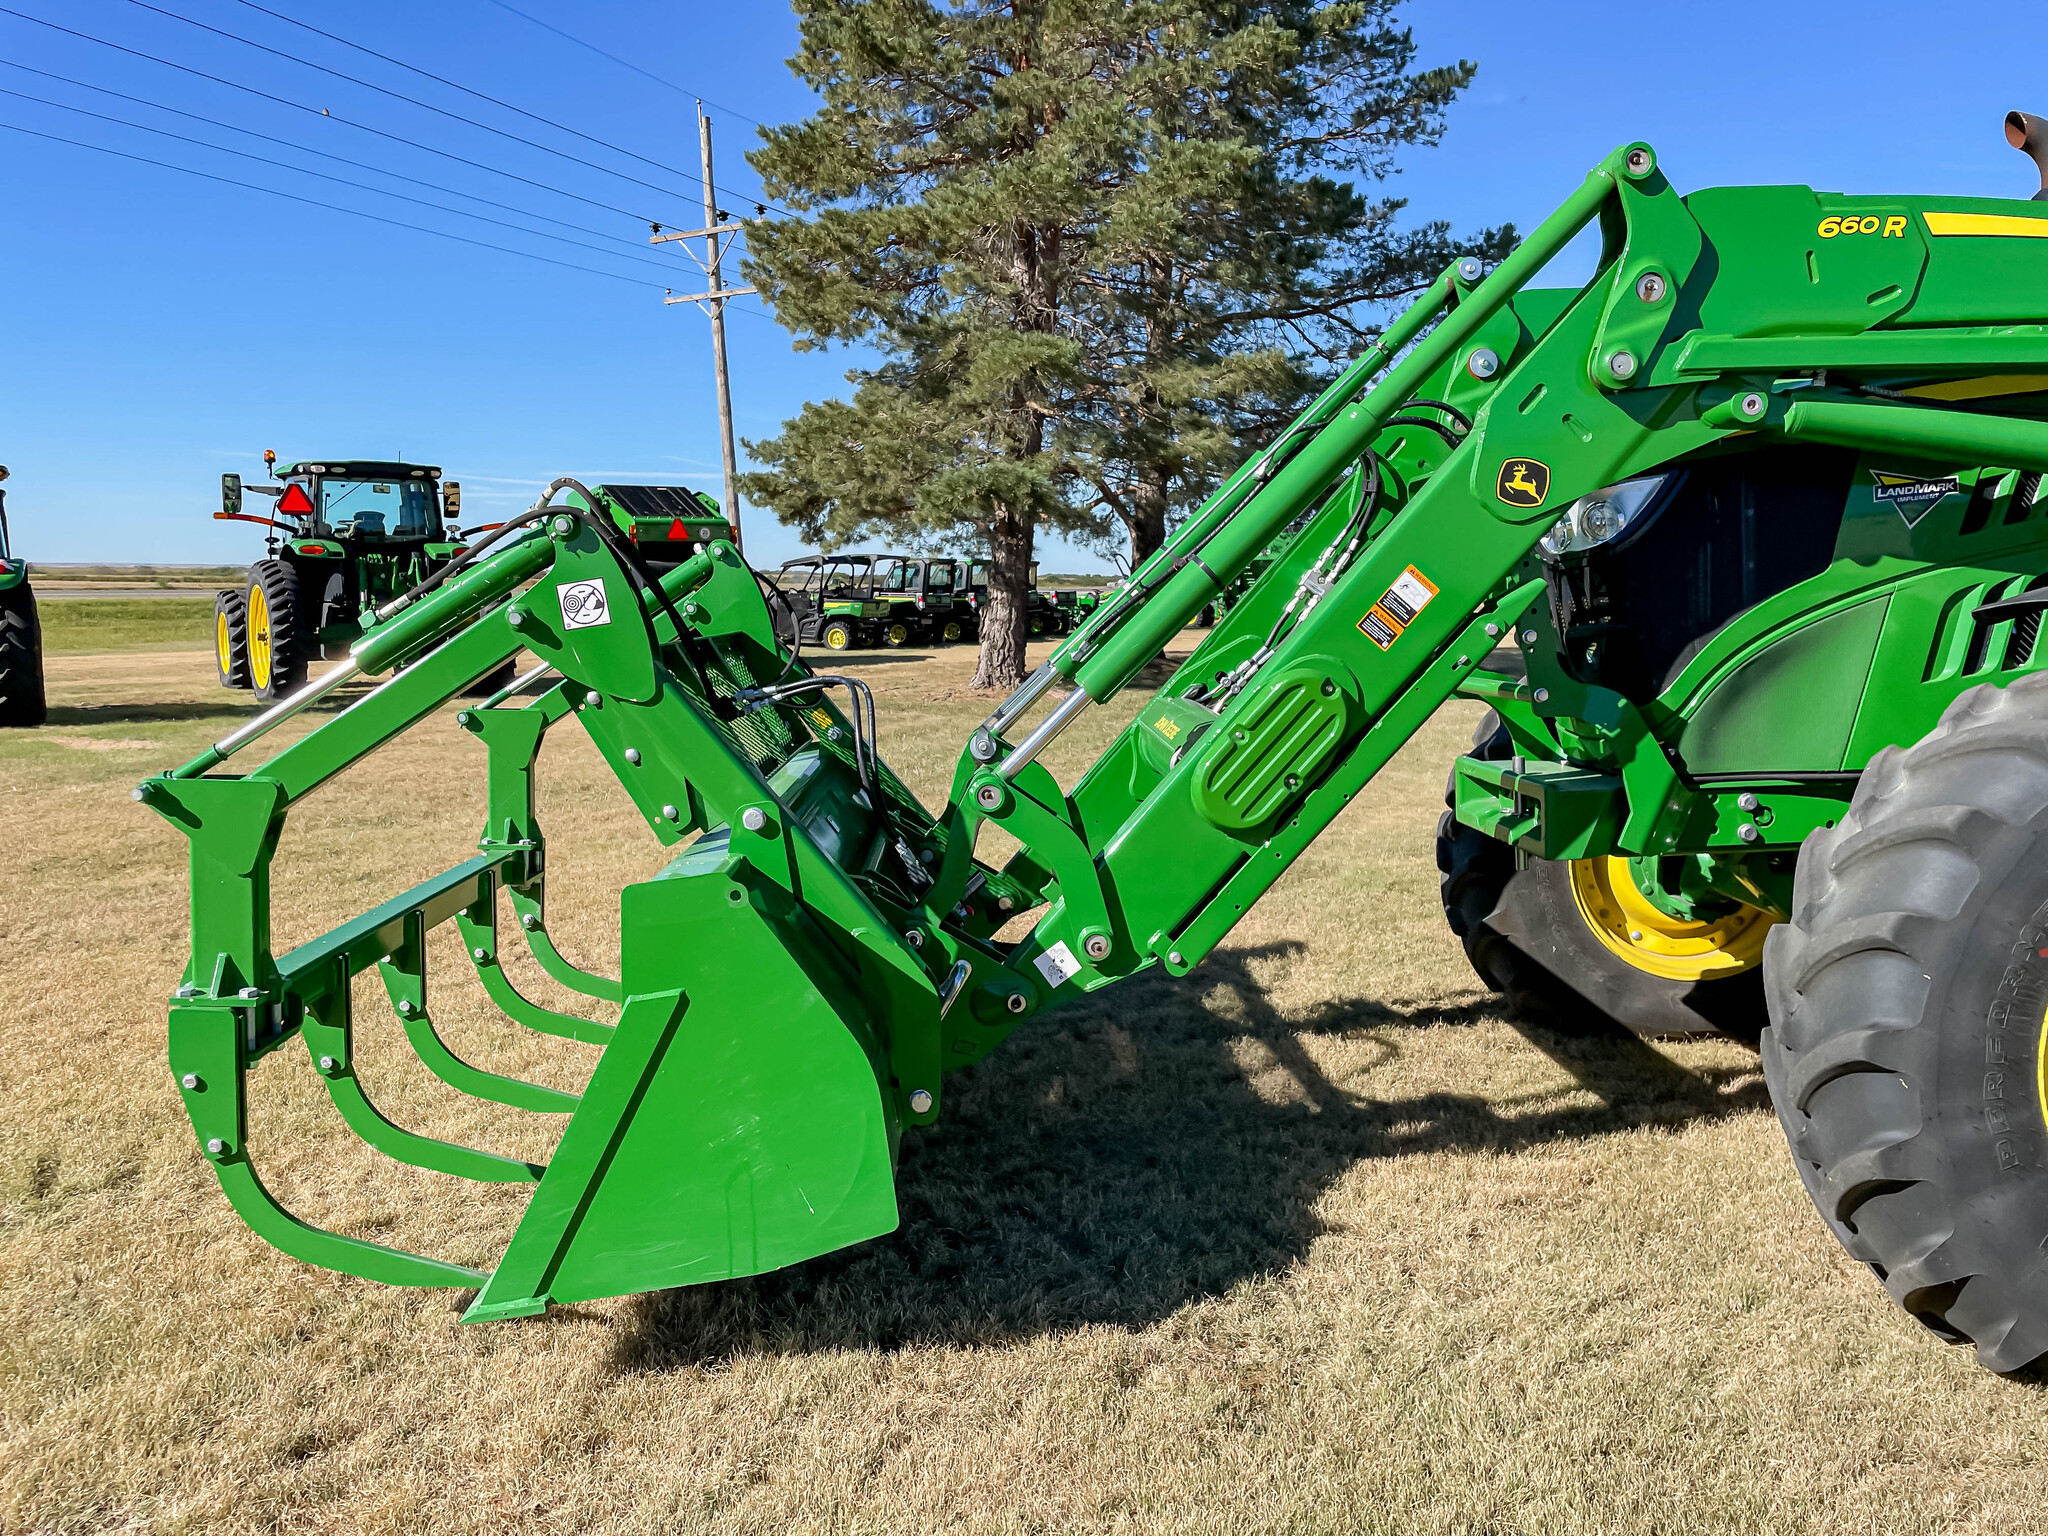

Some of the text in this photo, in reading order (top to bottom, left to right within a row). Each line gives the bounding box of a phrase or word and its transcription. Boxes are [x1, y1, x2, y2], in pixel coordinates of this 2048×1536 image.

[1817, 216, 1907, 238] 660 R
[1877, 482, 1955, 498] LANDMARK
[1415, 571, 1435, 591] WARNING
